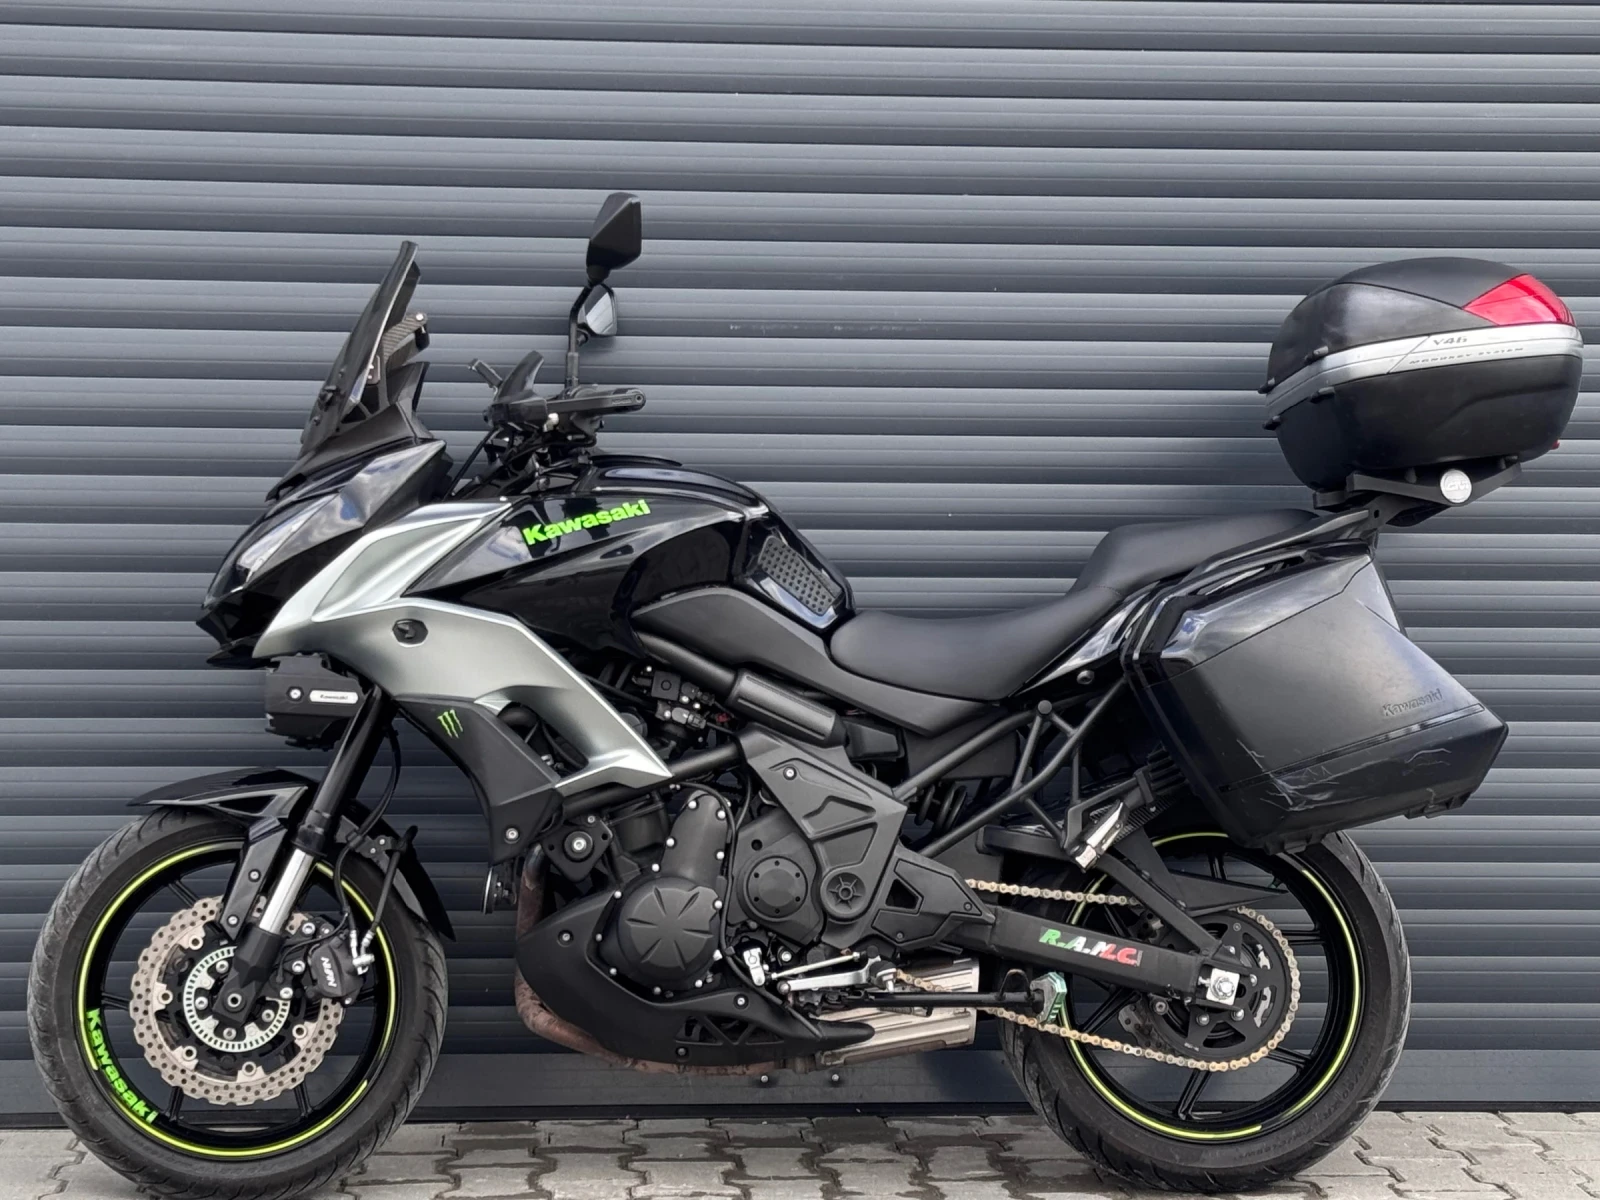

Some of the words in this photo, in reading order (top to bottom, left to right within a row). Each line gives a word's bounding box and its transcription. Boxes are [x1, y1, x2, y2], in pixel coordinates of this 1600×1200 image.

[1432, 335, 1469, 347] V46
[522, 499, 652, 546] Kawasaki
[1382, 688, 1444, 717] Kawasaki
[86, 1007, 159, 1124] Kawasaki
